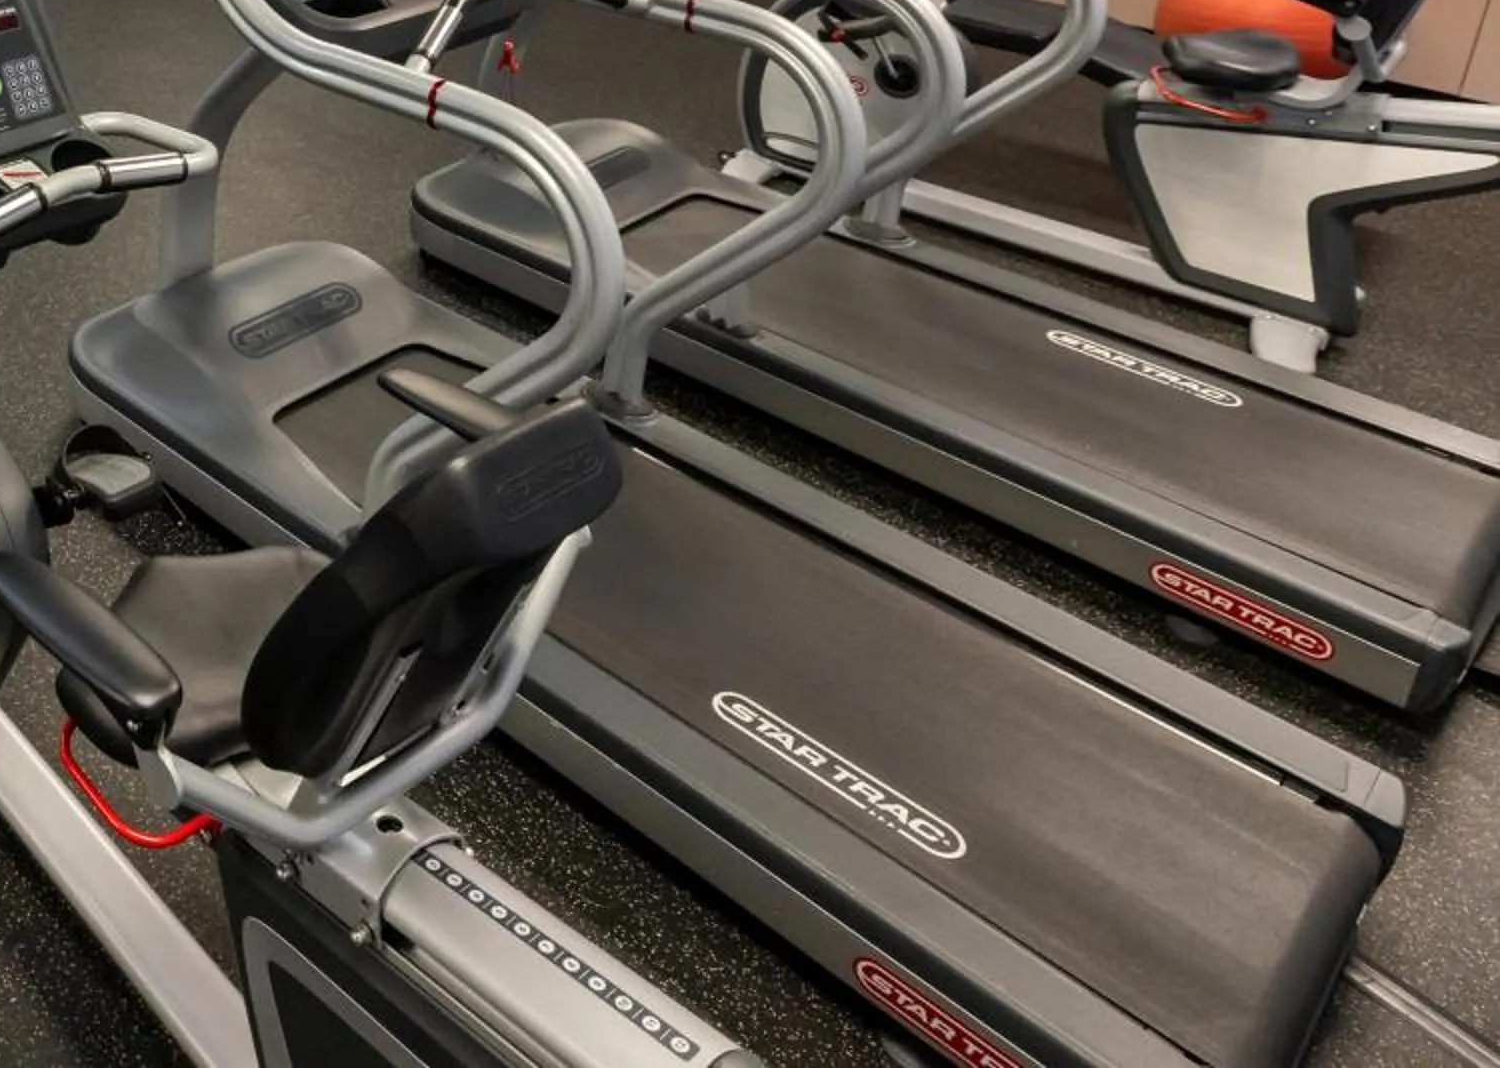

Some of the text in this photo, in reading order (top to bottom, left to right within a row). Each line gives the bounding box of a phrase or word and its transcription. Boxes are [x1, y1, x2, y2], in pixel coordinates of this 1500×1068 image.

[1057, 334, 1231, 401] STAR TRAC
[1159, 572, 1319, 650] STAR TRAC
[730, 702, 946, 843] STAR TRAC
[867, 973, 957, 1042] STAR
